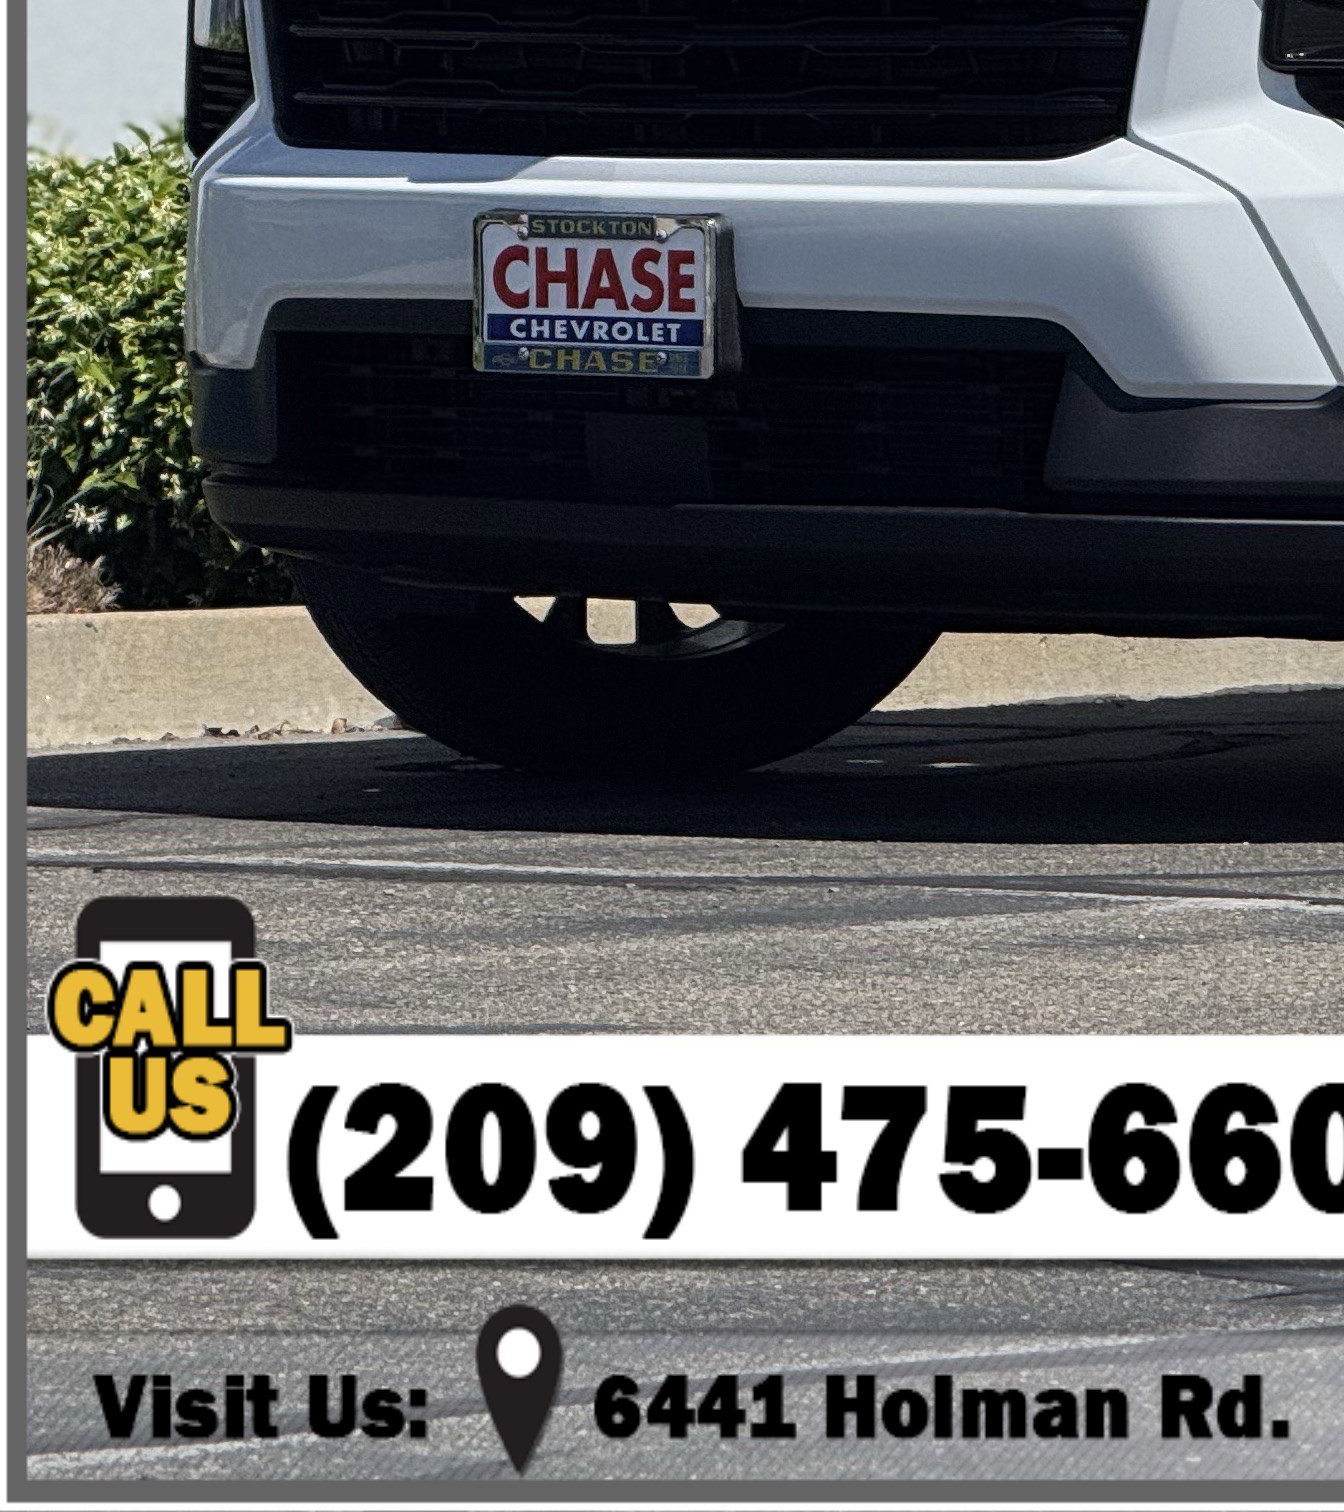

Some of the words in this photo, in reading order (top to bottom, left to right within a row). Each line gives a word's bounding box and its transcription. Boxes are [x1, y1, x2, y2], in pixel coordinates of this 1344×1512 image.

[530, 218, 652, 236] STOCKTON
[492, 245, 697, 313] CHASE
[509, 318, 682, 344] CHEVROLET
[528, 348, 659, 374] CHASE
